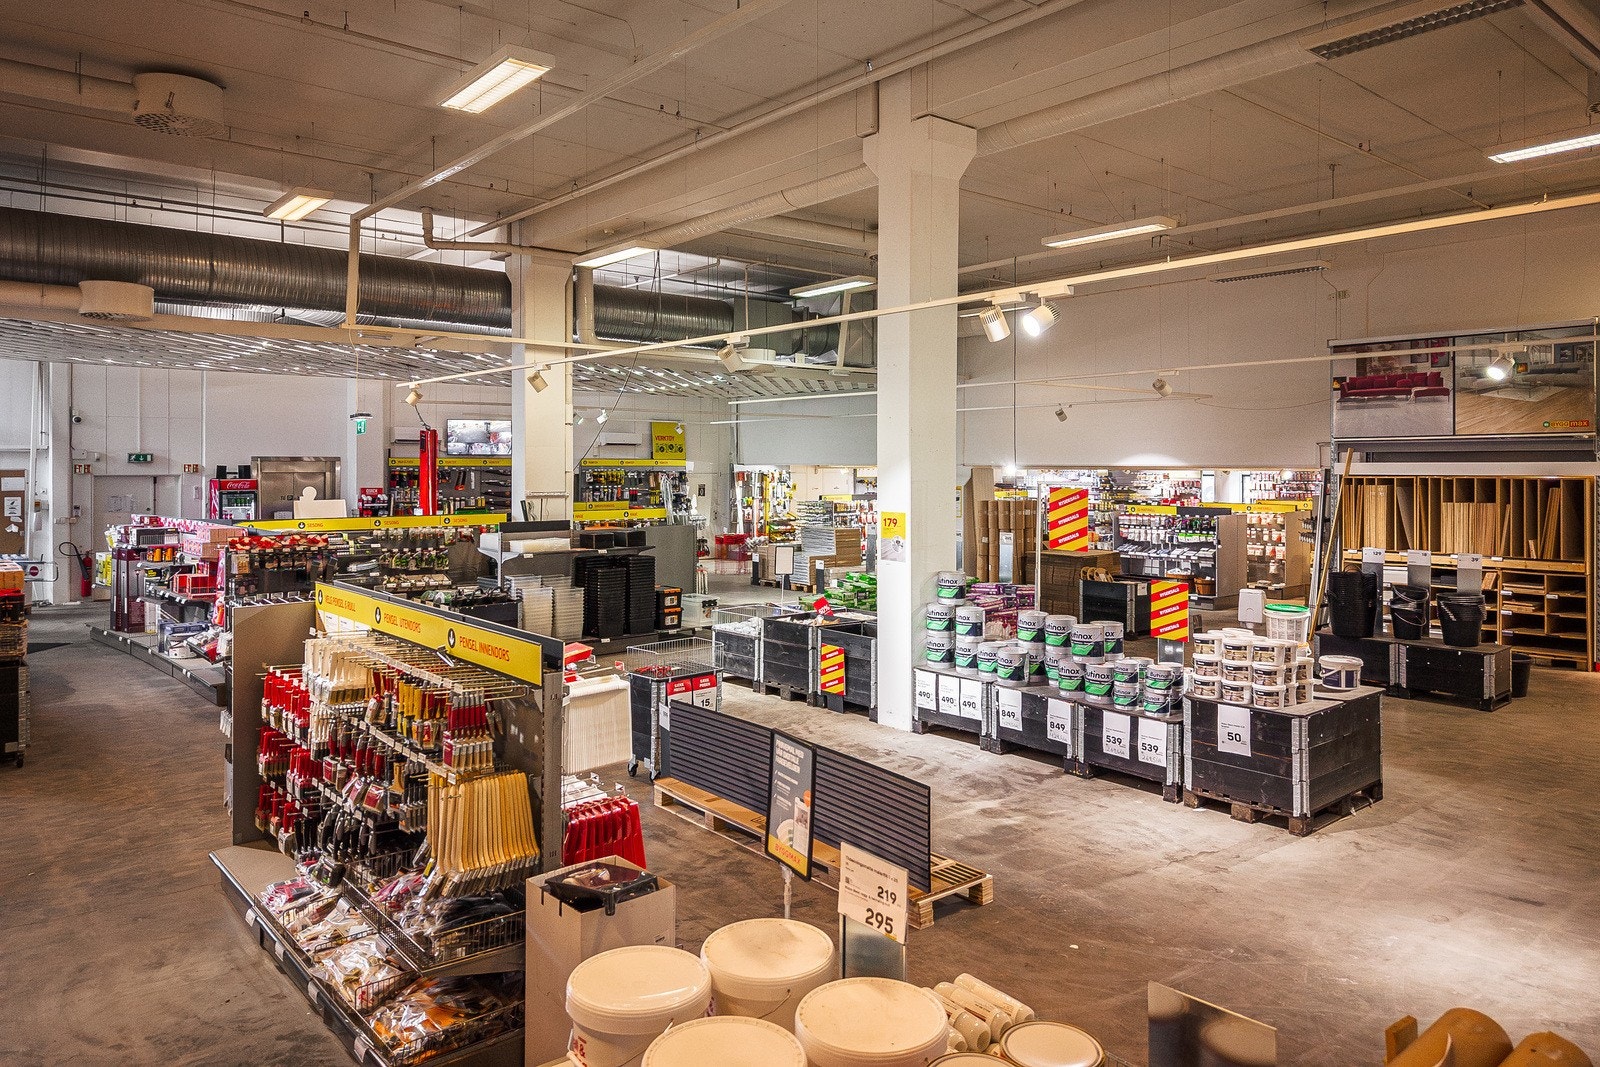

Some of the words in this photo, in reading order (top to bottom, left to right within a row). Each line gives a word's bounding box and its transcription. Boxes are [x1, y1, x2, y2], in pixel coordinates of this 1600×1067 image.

[883, 518, 898, 527] 179
[384, 612, 398, 627] PENSEL
[460, 636, 478, 652] PENSEL
[1086, 670, 1110, 680] utinox
[918, 691, 930, 699] 490
[942, 696, 954, 704] 490
[701, 698, 710, 708] 15
[962, 700, 976, 709] 490
[1001, 710, 1016, 718] 849
[1050, 722, 1066, 731] 849
[1106, 735, 1122, 746] 539
[1227, 732, 1242, 742] 50
[1142, 742, 1158, 753] 539
[877, 886, 897, 904] 219
[865, 908, 894, 934] 295
